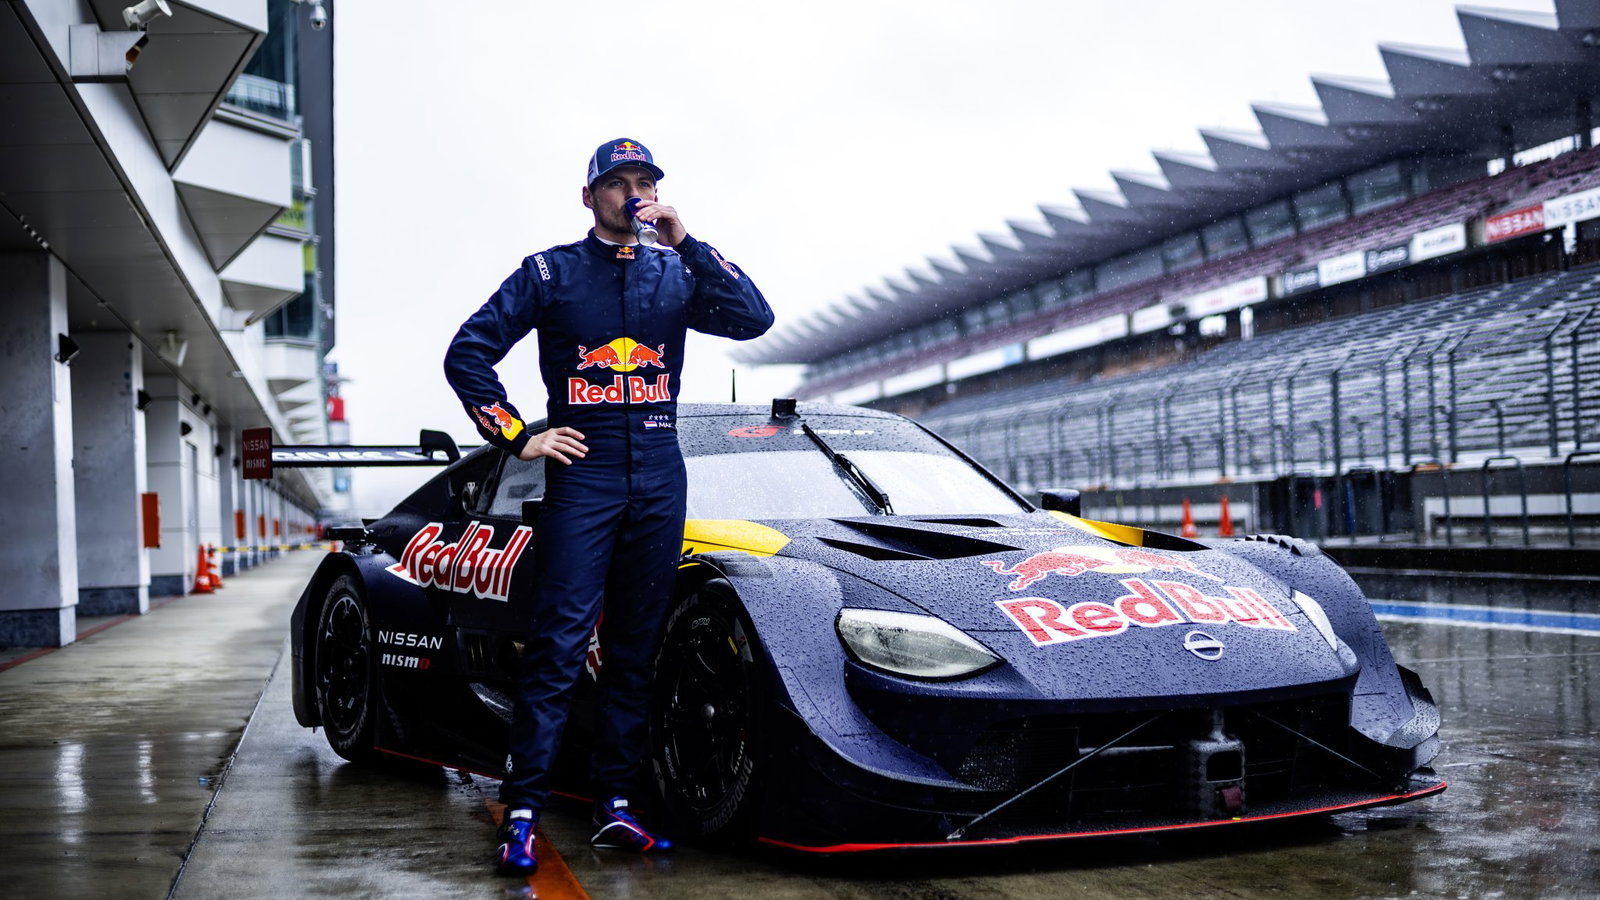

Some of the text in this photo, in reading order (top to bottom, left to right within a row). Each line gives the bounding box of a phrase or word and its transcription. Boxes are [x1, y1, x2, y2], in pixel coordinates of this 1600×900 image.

[611, 151, 630, 162] Red
[1547, 195, 1600, 218] NISSA
[568, 373, 670, 404] Red Bull
[243, 439, 269, 451] NISSAN
[384, 520, 533, 602] Red Bull
[993, 578, 1298, 646] Red Bull
[378, 630, 443, 650] NISSAN
